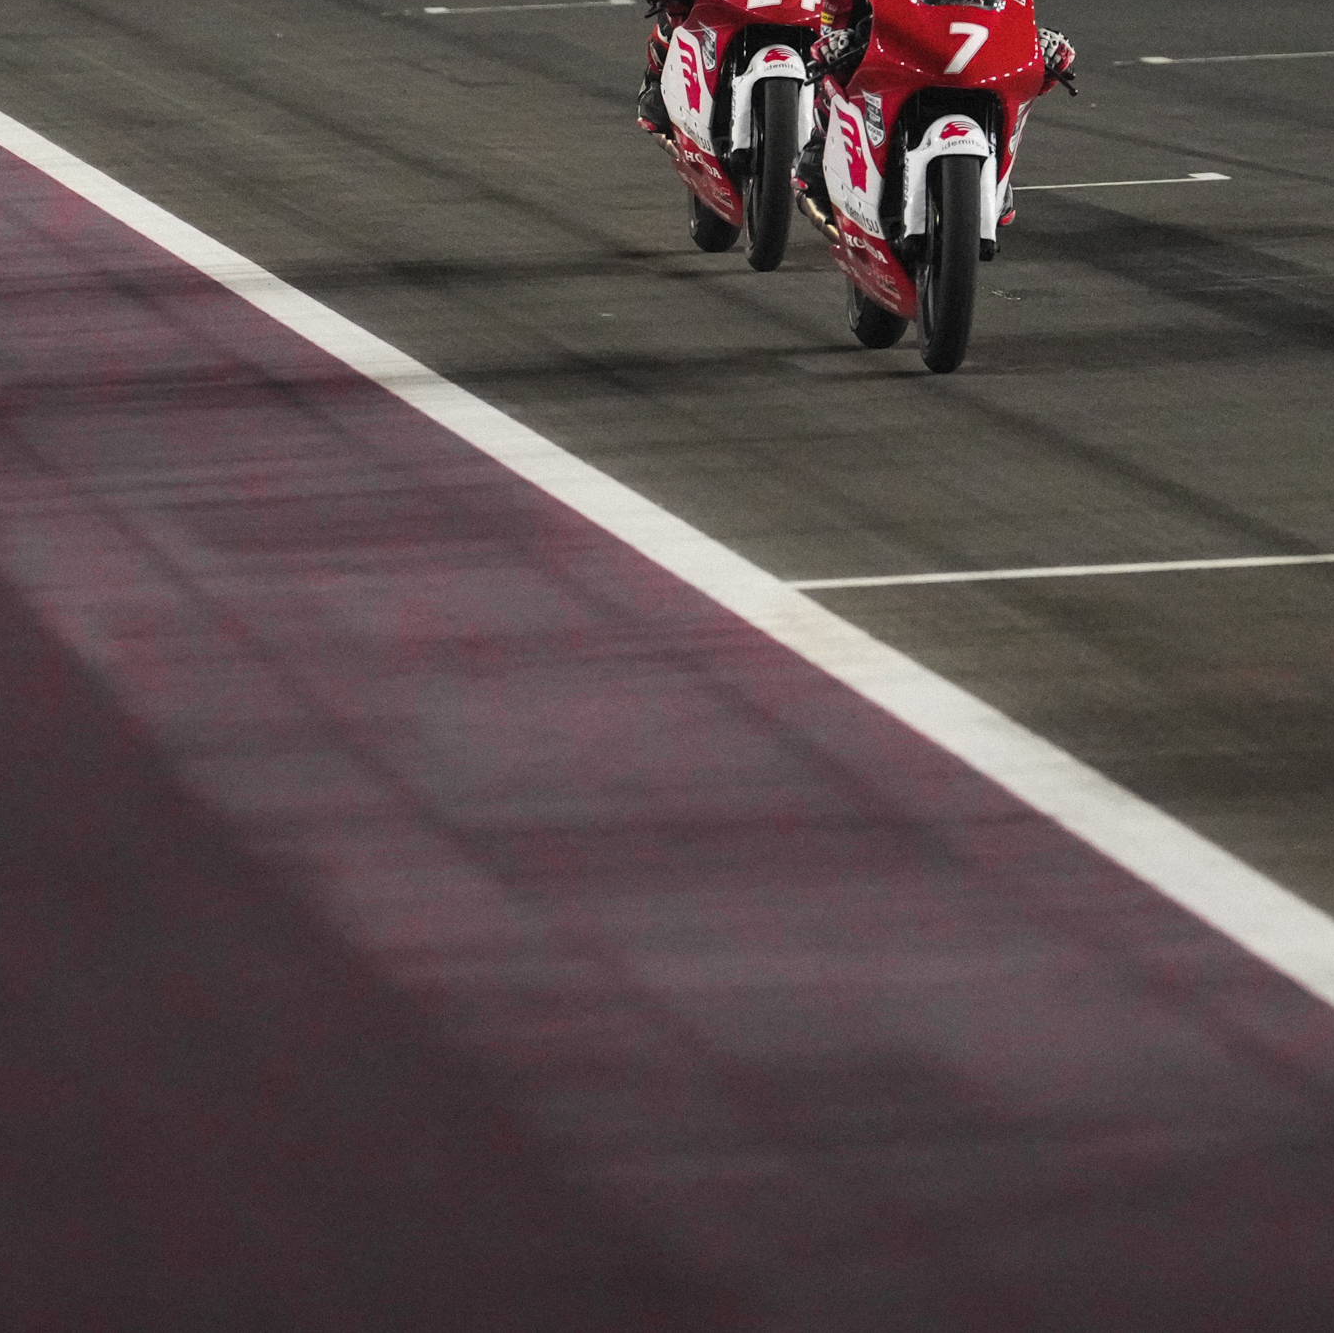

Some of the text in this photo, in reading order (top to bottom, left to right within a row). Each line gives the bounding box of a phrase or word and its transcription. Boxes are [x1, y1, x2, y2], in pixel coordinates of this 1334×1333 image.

[943, 21, 989, 75] 7
[683, 150, 723, 180] HODA
[844, 232, 889, 264] HODA
